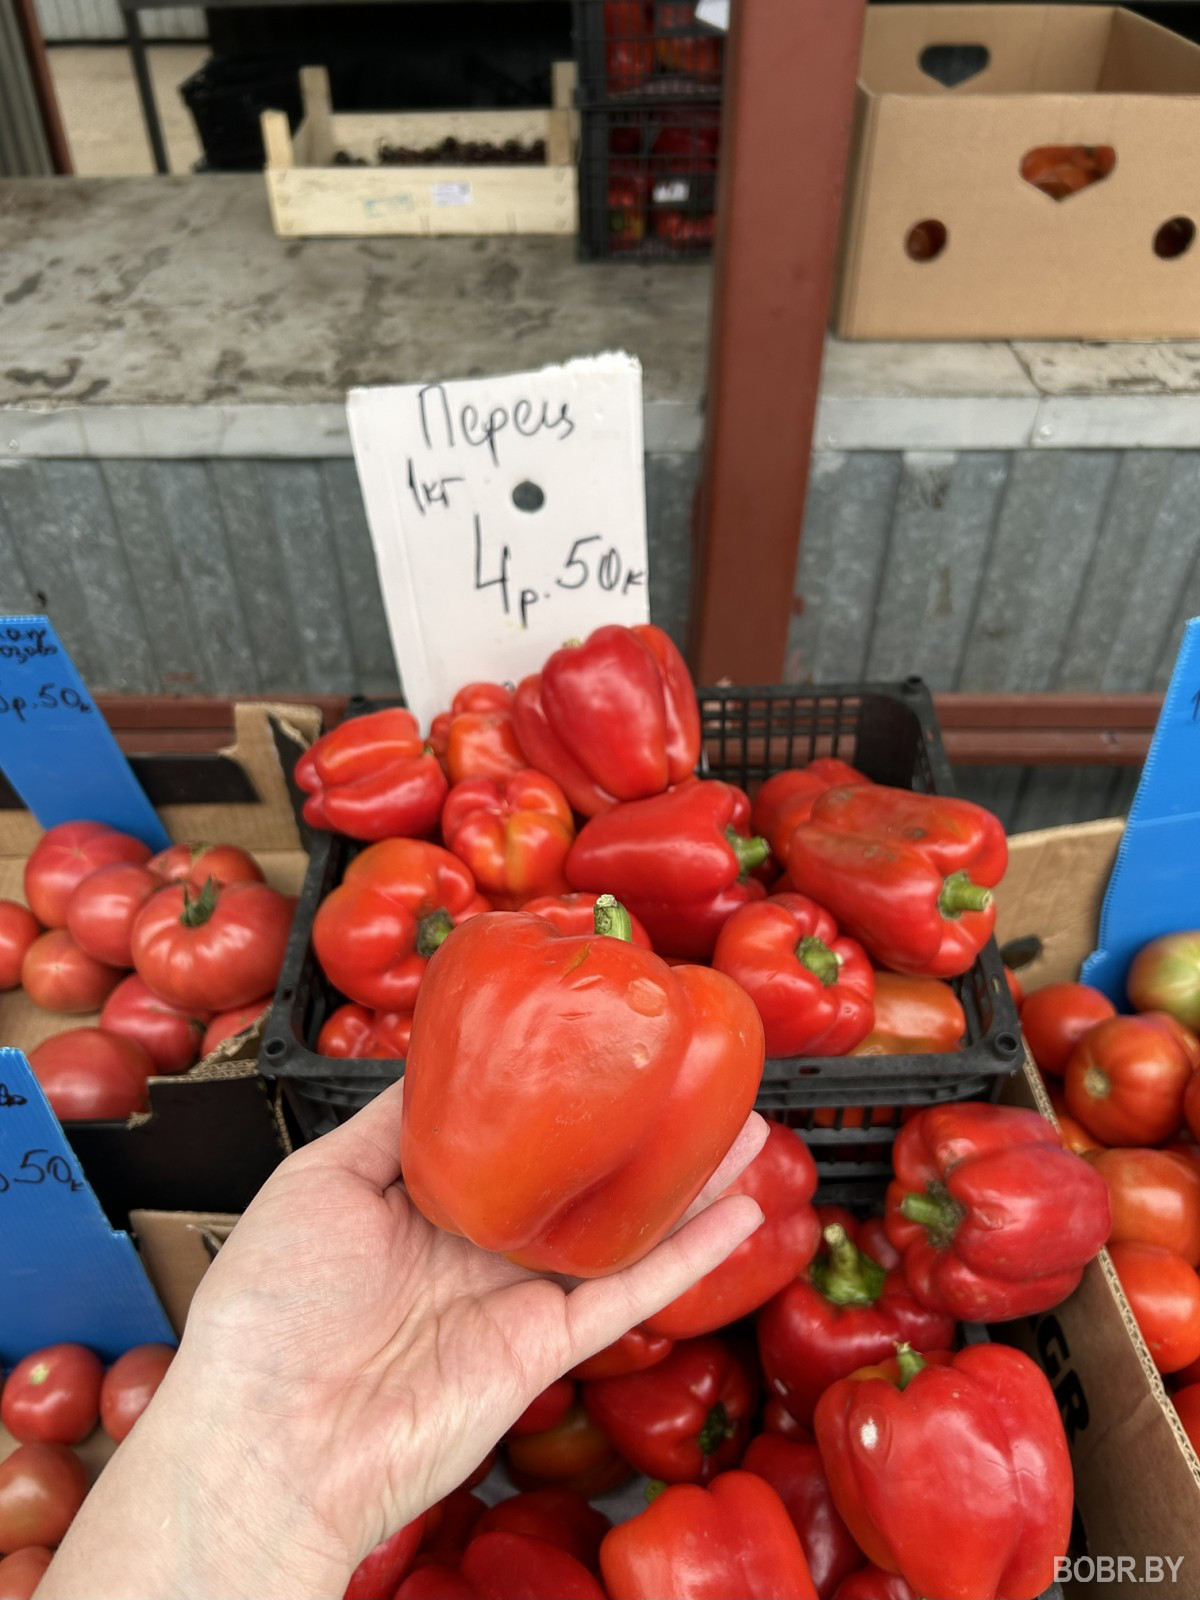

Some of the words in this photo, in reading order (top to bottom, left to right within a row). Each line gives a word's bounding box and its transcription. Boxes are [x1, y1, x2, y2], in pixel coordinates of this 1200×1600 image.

[419, 383, 575, 467] Перец
[407, 458, 465, 516] 1кг
[1032, 1314, 1090, 1446] GR
